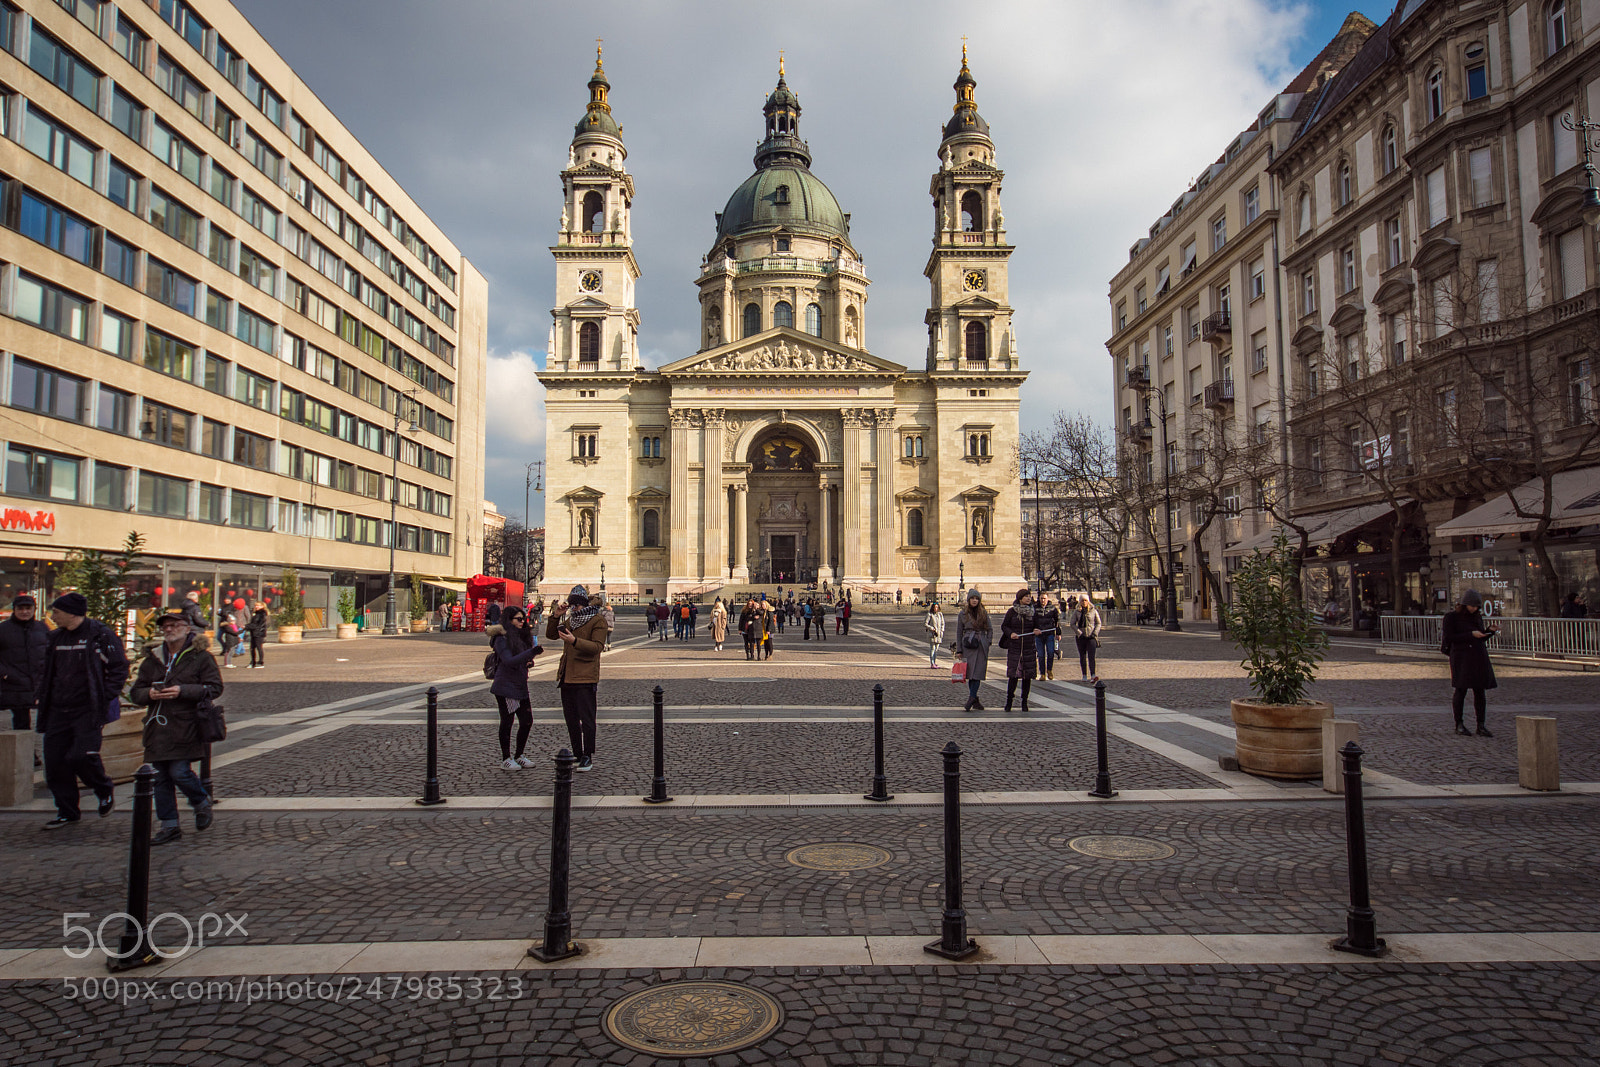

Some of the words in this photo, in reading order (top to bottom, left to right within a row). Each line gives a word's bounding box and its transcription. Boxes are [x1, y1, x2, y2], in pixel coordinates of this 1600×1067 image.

[1462, 569, 1500, 579] Forralt
[1491, 579, 1508, 588] bor
[1494, 601, 1506, 609] Ft
